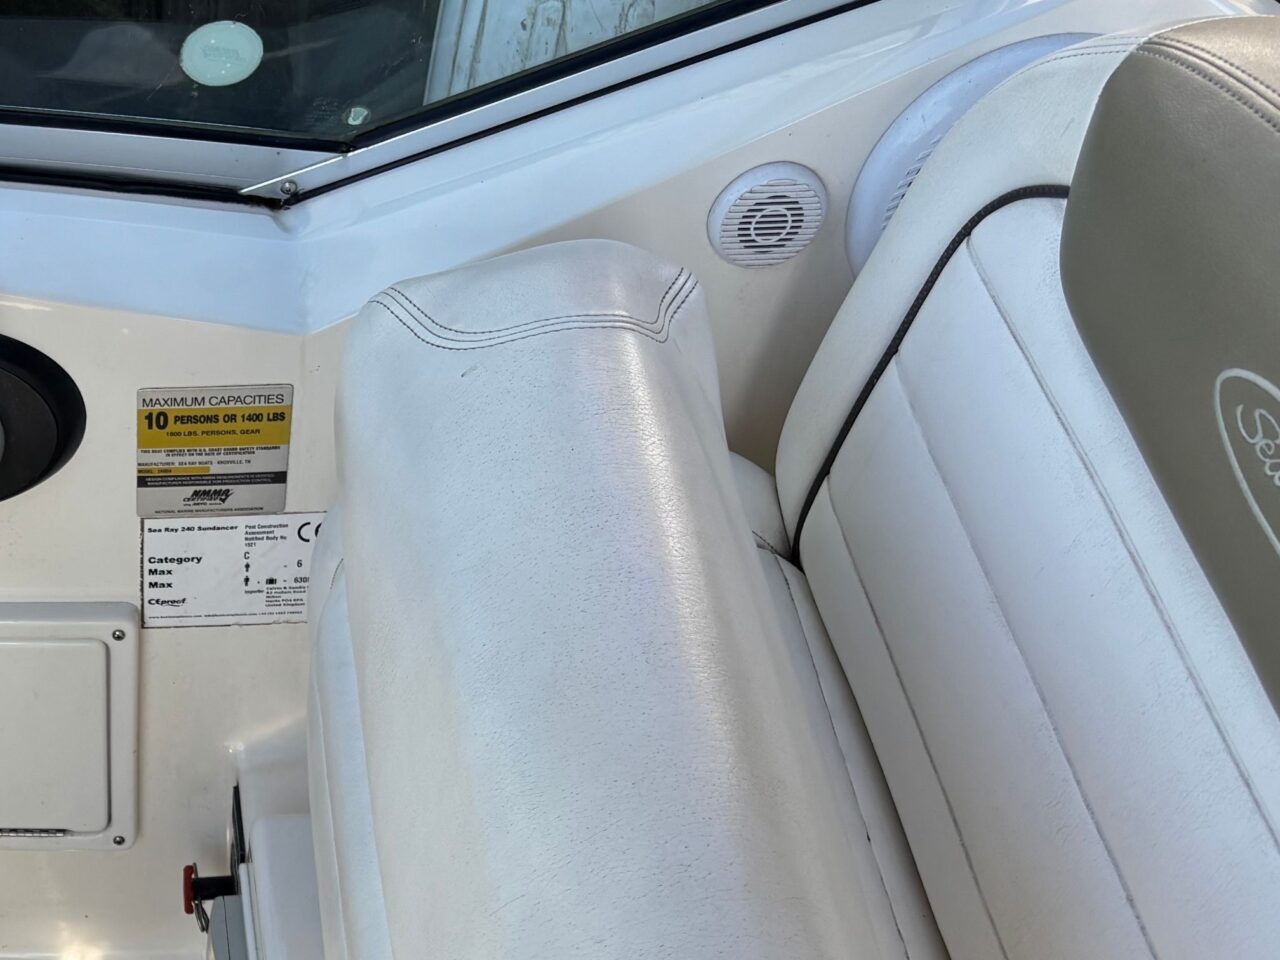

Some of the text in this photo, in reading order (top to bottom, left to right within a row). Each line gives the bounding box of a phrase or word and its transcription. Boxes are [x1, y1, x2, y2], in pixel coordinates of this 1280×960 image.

[142, 394, 284, 407] MAXIMUM CAPACITIES
[145, 412, 285, 430] 10 PERSONS OR 1400 LBS
[148, 556, 202, 565] Category
[297, 560, 302, 568] 6
